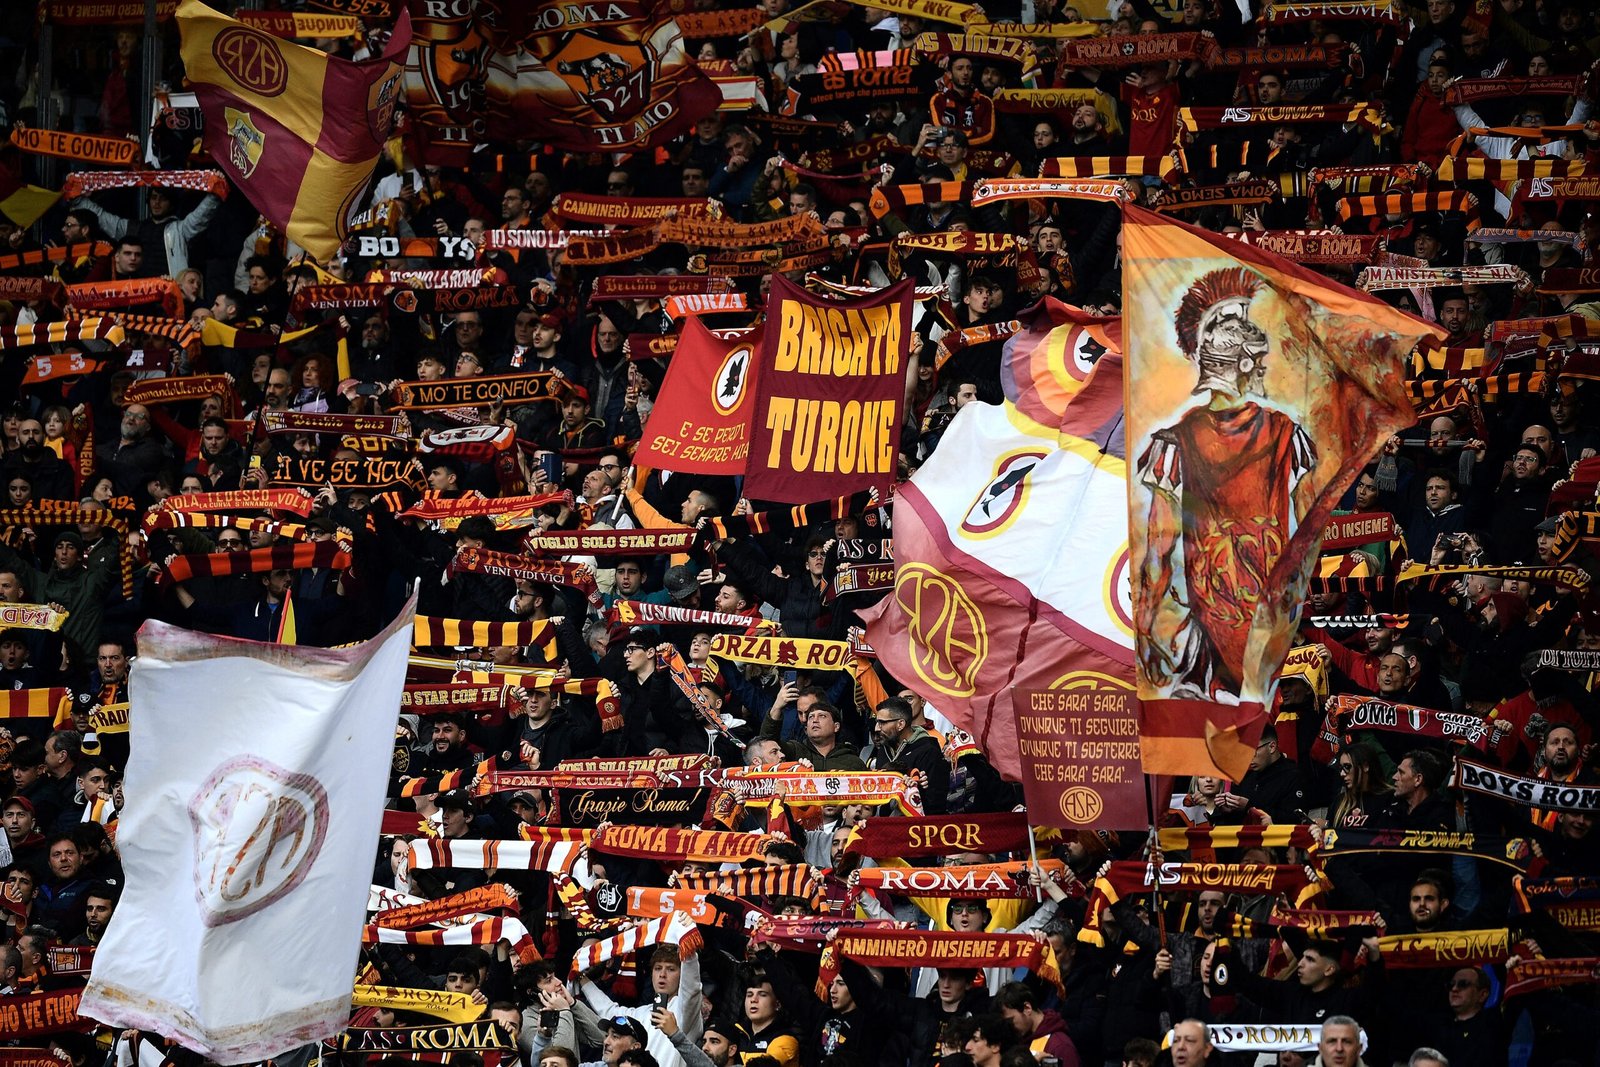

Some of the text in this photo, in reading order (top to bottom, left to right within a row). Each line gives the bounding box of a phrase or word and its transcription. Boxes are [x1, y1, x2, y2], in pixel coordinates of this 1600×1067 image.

[1076, 39, 1179, 59] FORZA ROMA
[852, 66, 913, 87] roma
[17, 128, 132, 161] MO' TE GONFIO
[563, 198, 630, 218] CAMMINERÒ
[491, 229, 506, 248] IO
[507, 229, 547, 248] SONO
[548, 229, 568, 248] LA
[1262, 237, 1304, 255] FORZA
[1321, 237, 1362, 255] ROMA
[450, 268, 483, 289] ROMA
[435, 285, 520, 306] ROMA
[673, 292, 744, 313] FORZA
[774, 297, 902, 376] BRIGATA
[418, 379, 540, 403] MO' TE GONFIO
[680, 420, 693, 438] E
[692, 426, 713, 444] SE
[766, 396, 897, 475] TURONE
[650, 435, 682, 457] SEI
[680, 445, 732, 463] SEMPRE
[208, 490, 270, 504] TEDESCO
[277, 492, 309, 511] VOLA
[209, 501, 232, 510] CURVA
[1342, 516, 1390, 540] INSIEME
[529, 534, 687, 550] VOGLIO SOLO STAR CON
[485, 550, 565, 576] ROMA
[483, 564, 565, 585] VENI VIDI VICI
[692, 608, 710, 625] LA
[711, 611, 753, 627] ROMA
[414, 686, 500, 707] STAR CON TE
[1031, 693, 1055, 711] CHE
[1058, 694, 1092, 712] SARA'
[1070, 717, 1083, 735] TI
[1065, 740, 1078, 759] TI
[627, 759, 657, 772] STAR
[656, 757, 680, 771] CON
[681, 756, 700, 771] TE
[1033, 763, 1055, 782] CHE
[1057, 764, 1090, 783] SARA'
[500, 775, 624, 788] ROMA ROMA
[1463, 765, 1535, 802] BOYS
[568, 789, 627, 824] Grazie
[631, 788, 703, 813] Roma!
[602, 825, 759, 858] ROMA TI AMO
[908, 822, 985, 851] SPQR
[878, 869, 1011, 891] ROMA
[836, 936, 1037, 959] CAMMINERÒ INSIEME A TE
[1434, 933, 1509, 962] ROMA
[404, 988, 467, 1010] ROMA
[22, 998, 46, 1031] VE
[411, 1021, 502, 1050] ROMA
[1246, 1025, 1313, 1044] ROMA
